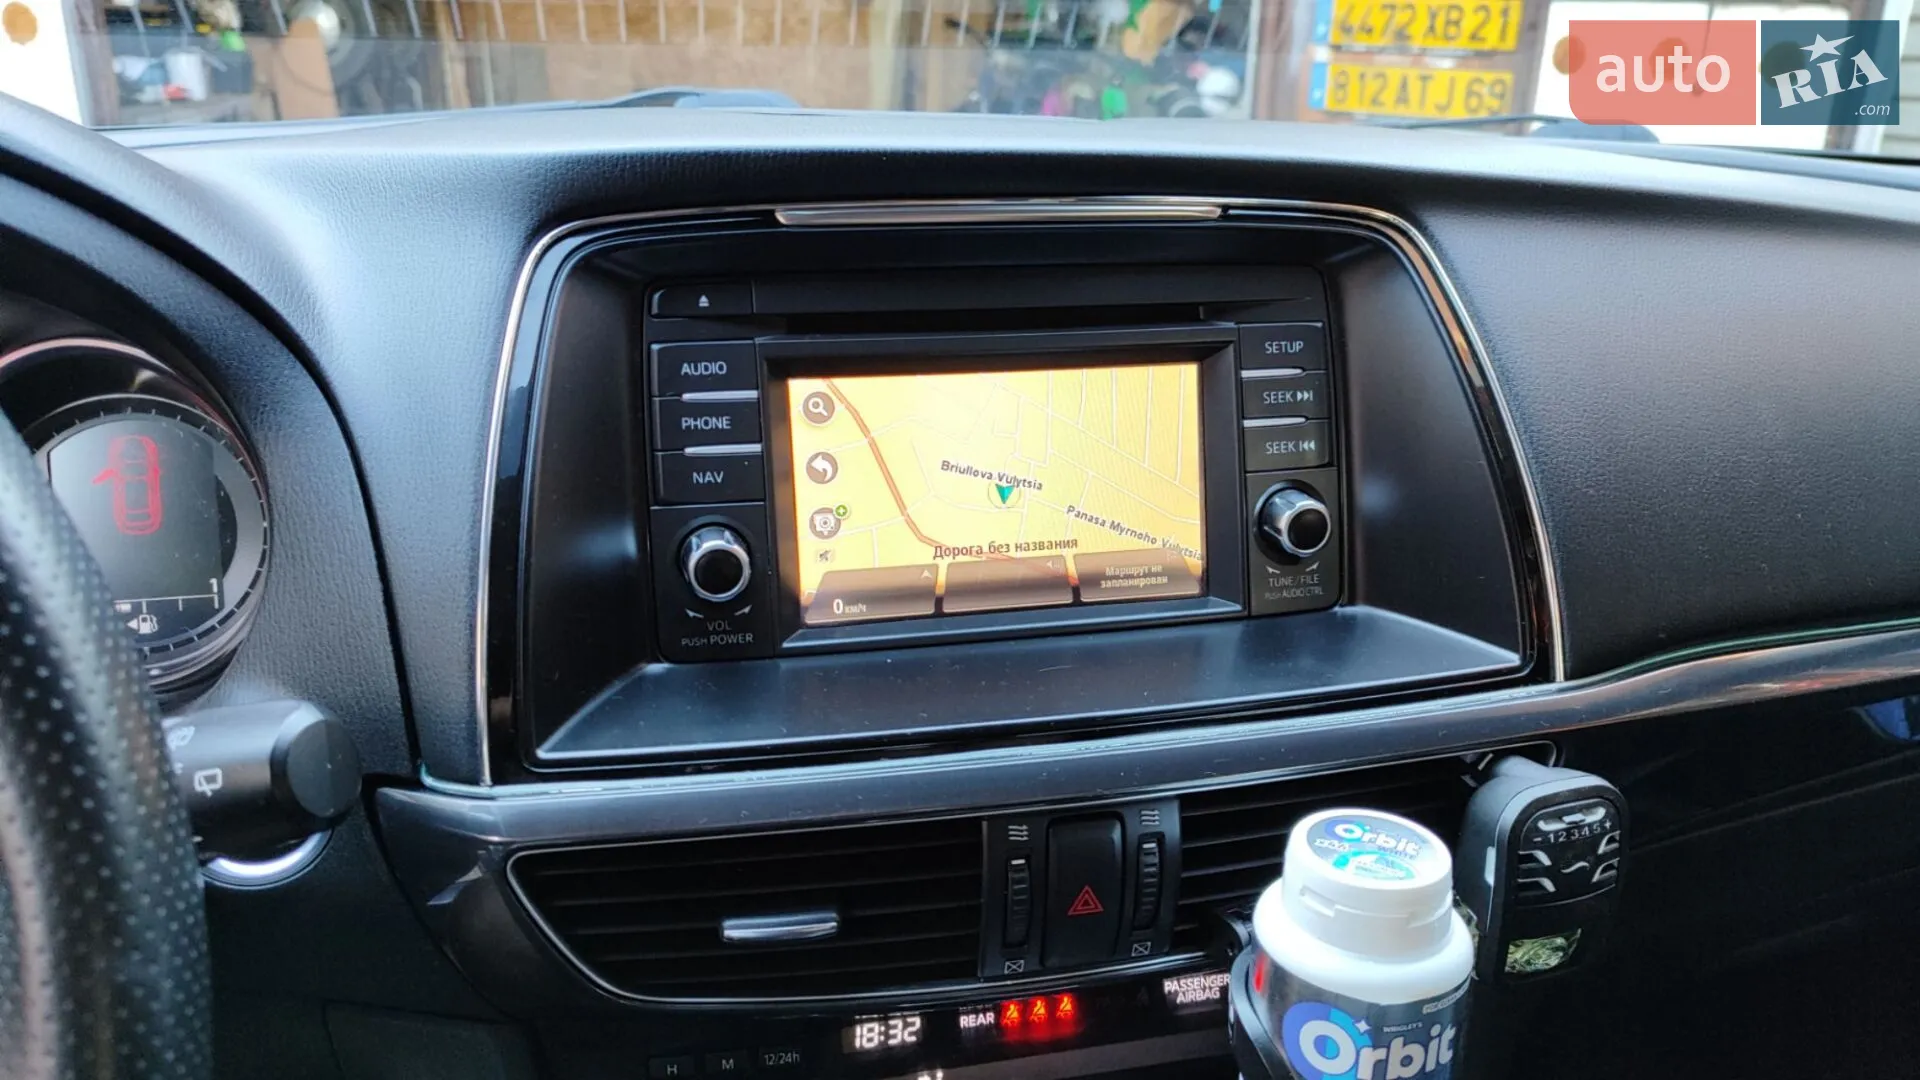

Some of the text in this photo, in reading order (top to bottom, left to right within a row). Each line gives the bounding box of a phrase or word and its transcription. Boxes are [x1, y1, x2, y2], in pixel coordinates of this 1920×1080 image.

[1393, 72, 1456, 115] ATJ
[1463, 77, 1507, 116] 69
[1264, 341, 1304, 354] SETUP
[680, 361, 727, 376] AUDIO
[1263, 391, 1294, 404] SEEK
[681, 416, 732, 430] PHONE
[1265, 440, 1297, 454] SEEK
[692, 471, 724, 484] NAV
[940, 459, 1043, 491] Briullova Vulytsia
[1066, 504, 1106, 528] Panasa
[1109, 519, 1158, 545] Myrnoho
[933, 538, 1078, 560] Дорога без названия
[833, 598, 844, 614] 0
[706, 620, 733, 631] VOL
[681, 632, 754, 646] PUSH POWER
[1334, 823, 1421, 855] Orbit
[1163, 973, 1231, 995] PASSENGER
[1176, 987, 1220, 1004] AIRBAG
[959, 1012, 995, 1029] REAR
[854, 1015, 922, 1049] 18:32
[1298, 1019, 1457, 1080] Orbit
[721, 1058, 734, 1070] M
[764, 1052, 800, 1065] 12/24h
[666, 1064, 678, 1075] H
